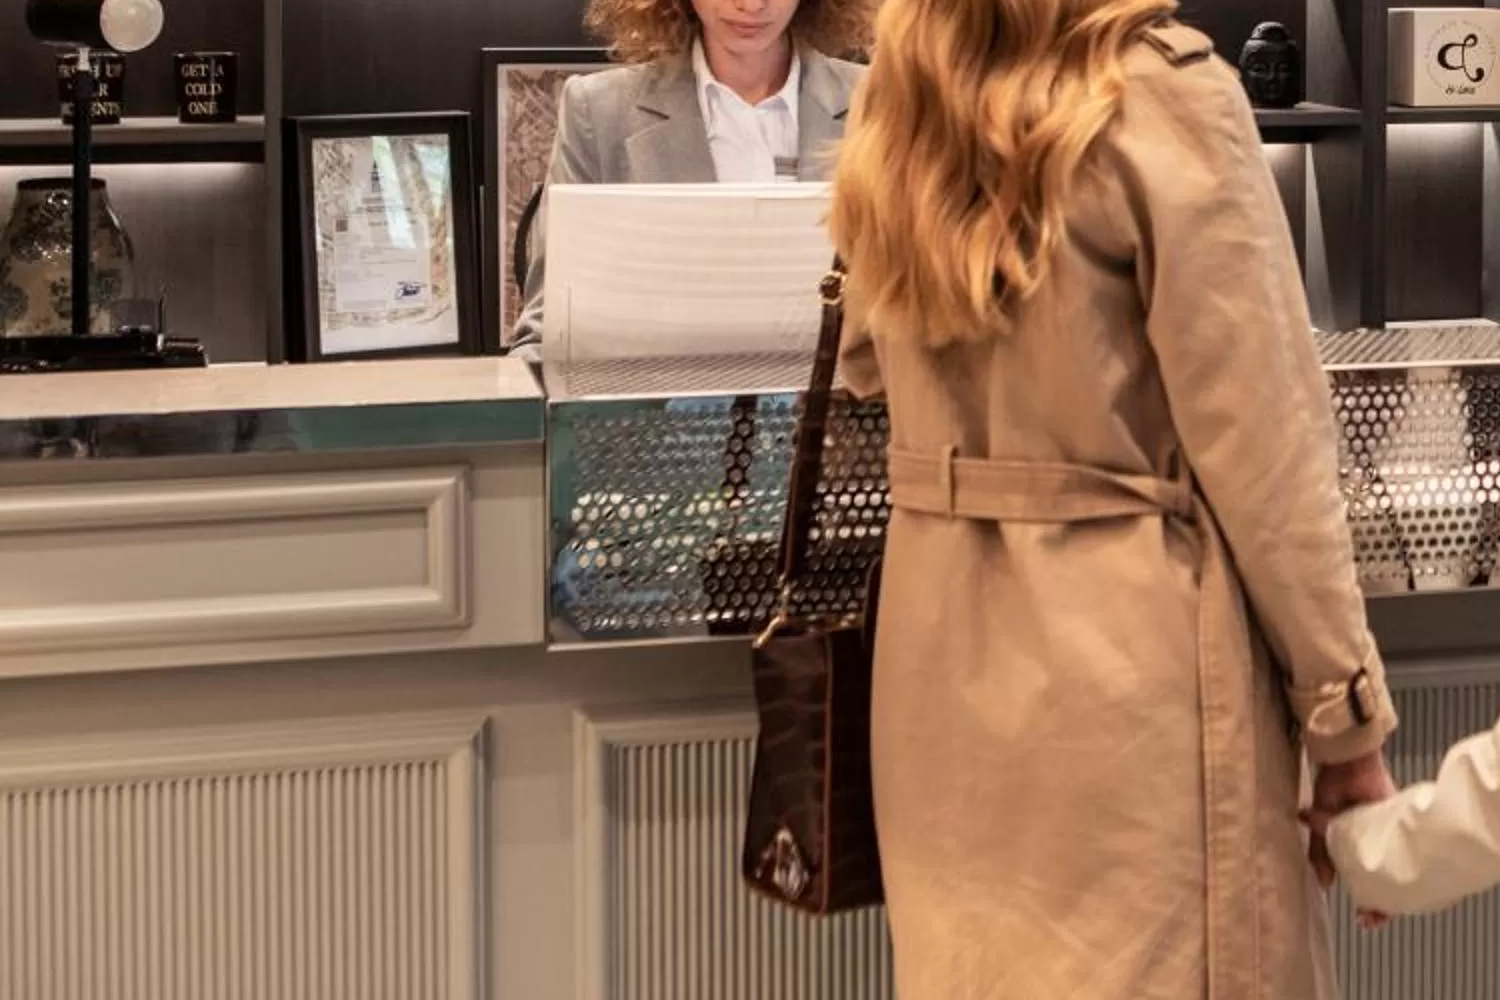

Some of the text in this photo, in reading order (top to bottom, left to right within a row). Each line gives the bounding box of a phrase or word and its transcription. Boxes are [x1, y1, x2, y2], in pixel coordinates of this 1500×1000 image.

[180, 64, 209, 78] GET
[184, 82, 222, 97] COLD
[187, 100, 218, 116] ONE
